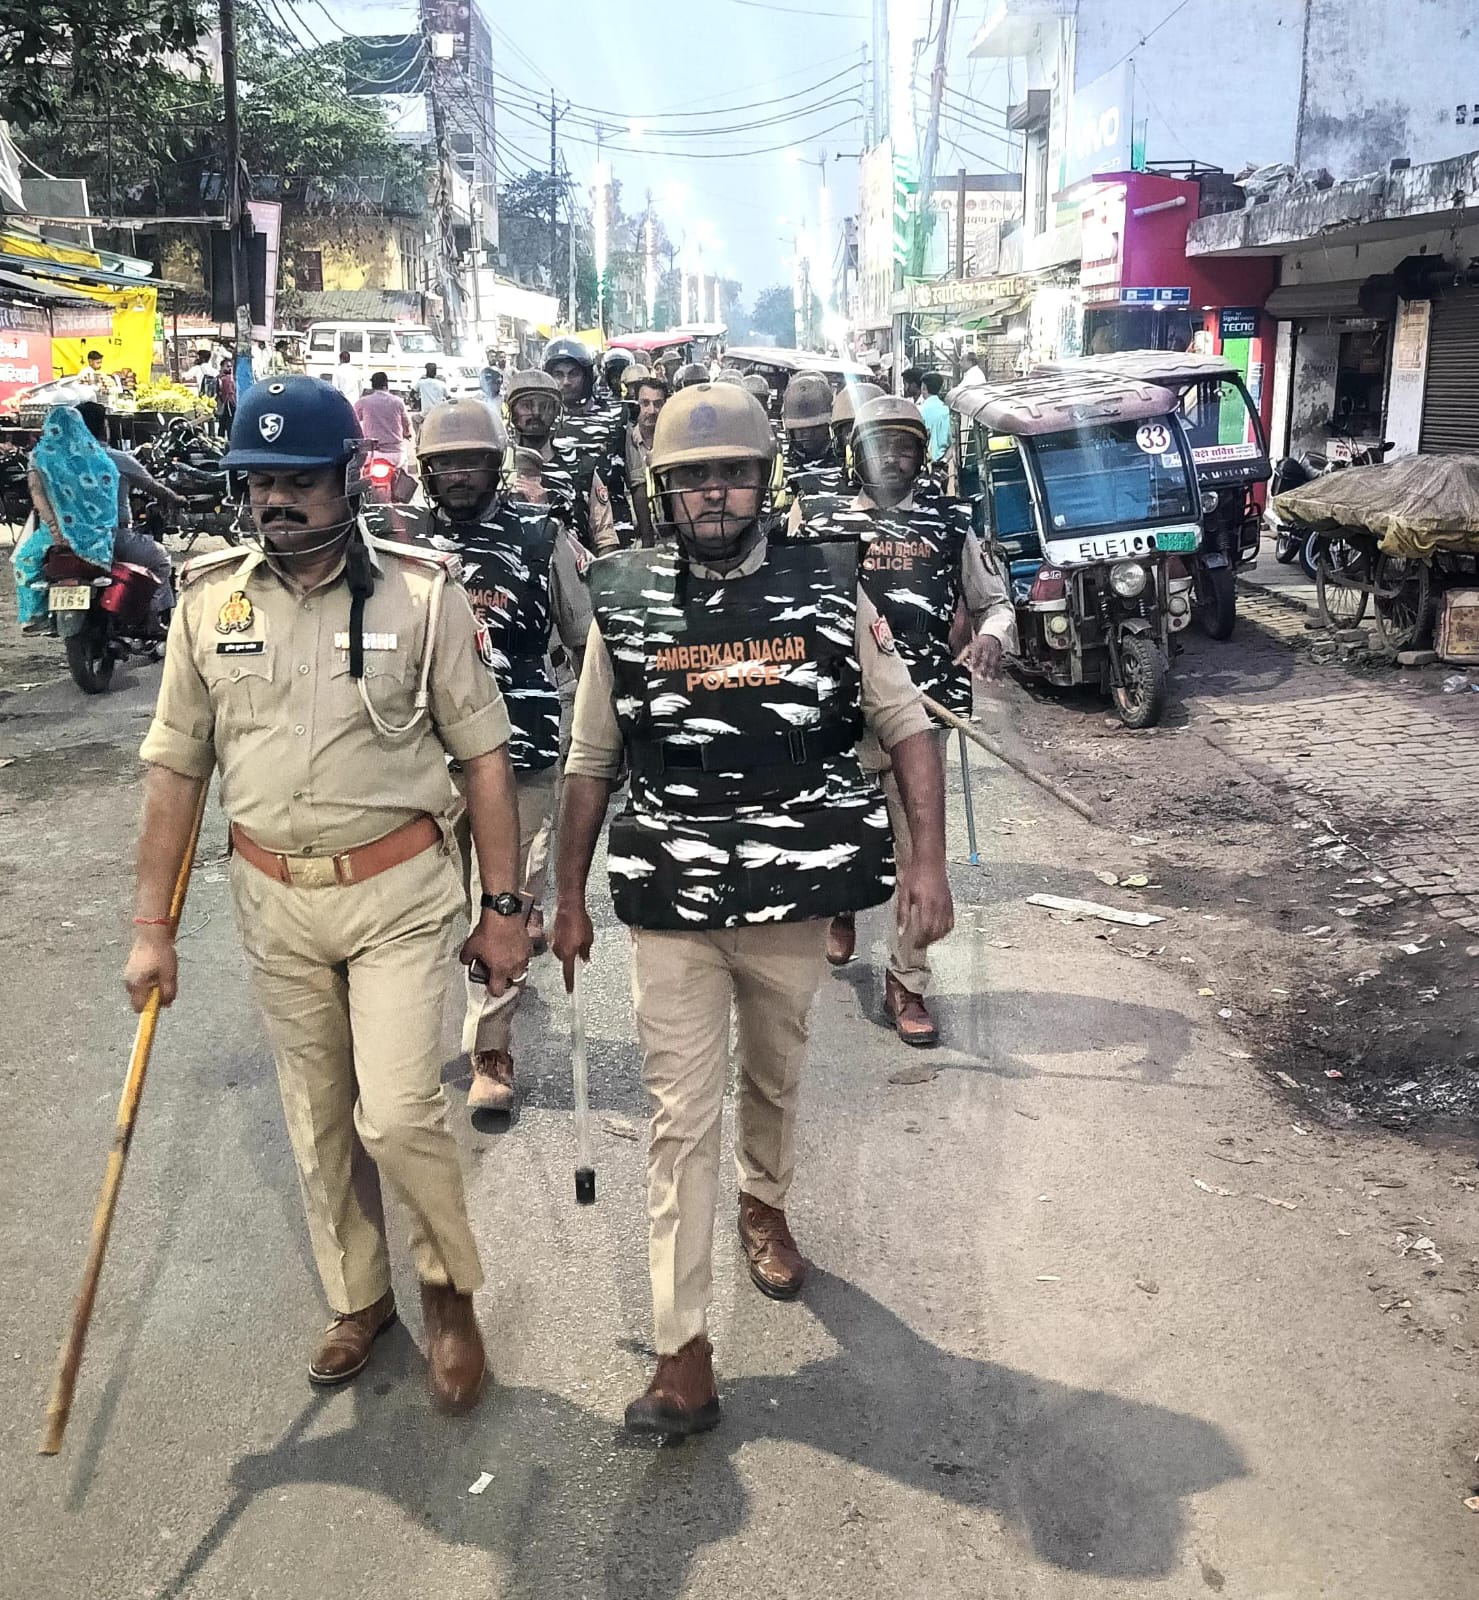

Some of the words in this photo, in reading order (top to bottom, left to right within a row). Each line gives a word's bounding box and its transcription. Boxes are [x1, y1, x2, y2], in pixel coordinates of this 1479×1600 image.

[1222, 322, 1255, 332] TECNO
[1140, 425, 1167, 449] 33
[895, 540, 932, 558] NAGAR
[862, 557, 913, 571] OLICE
[656, 641, 745, 672] AMBEDKAR
[748, 635, 806, 662] NAGAR
[685, 664, 781, 692] POLICE
